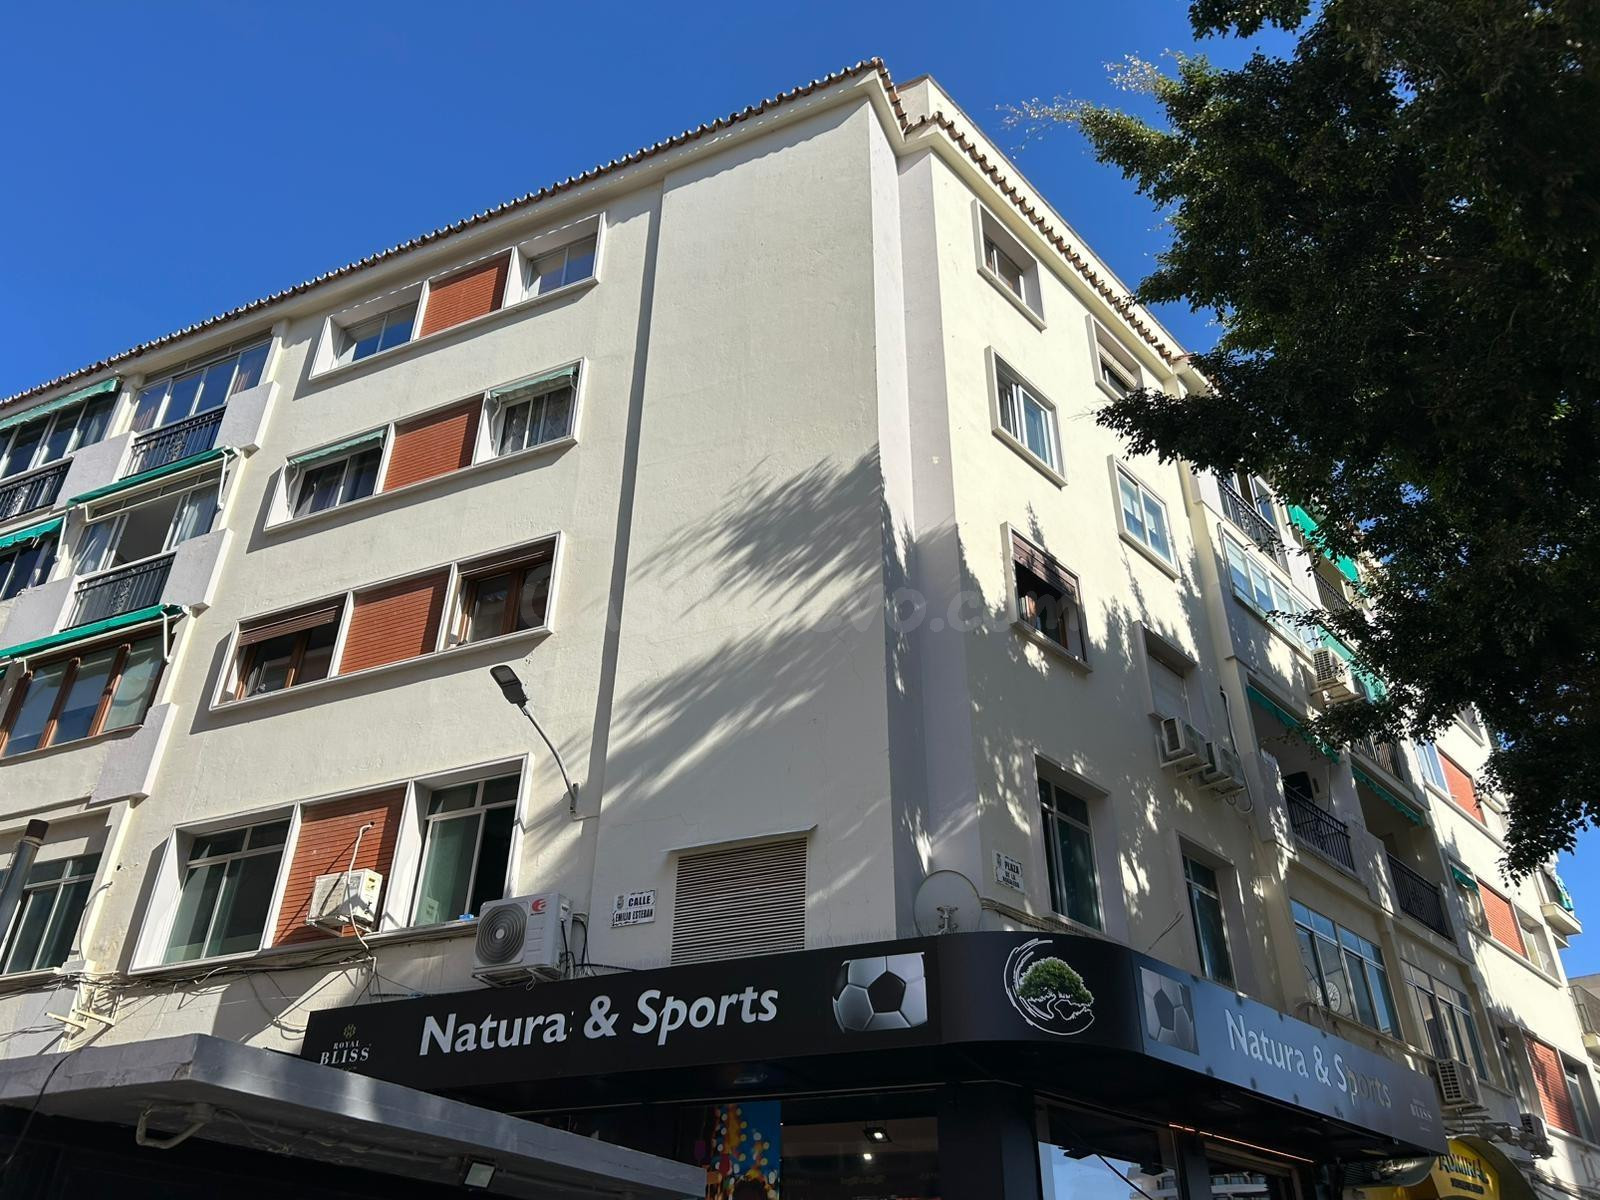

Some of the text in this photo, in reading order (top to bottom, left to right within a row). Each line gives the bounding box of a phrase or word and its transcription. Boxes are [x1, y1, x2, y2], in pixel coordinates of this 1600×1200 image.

[628, 895, 651, 907] CALLE
[615, 908, 653, 922] EMILIO ESTEBAN
[419, 986, 778, 1056] Natura & Sports
[319, 1047, 370, 1065] BLISS
[1224, 1008, 1392, 1109] Natura & Sports
